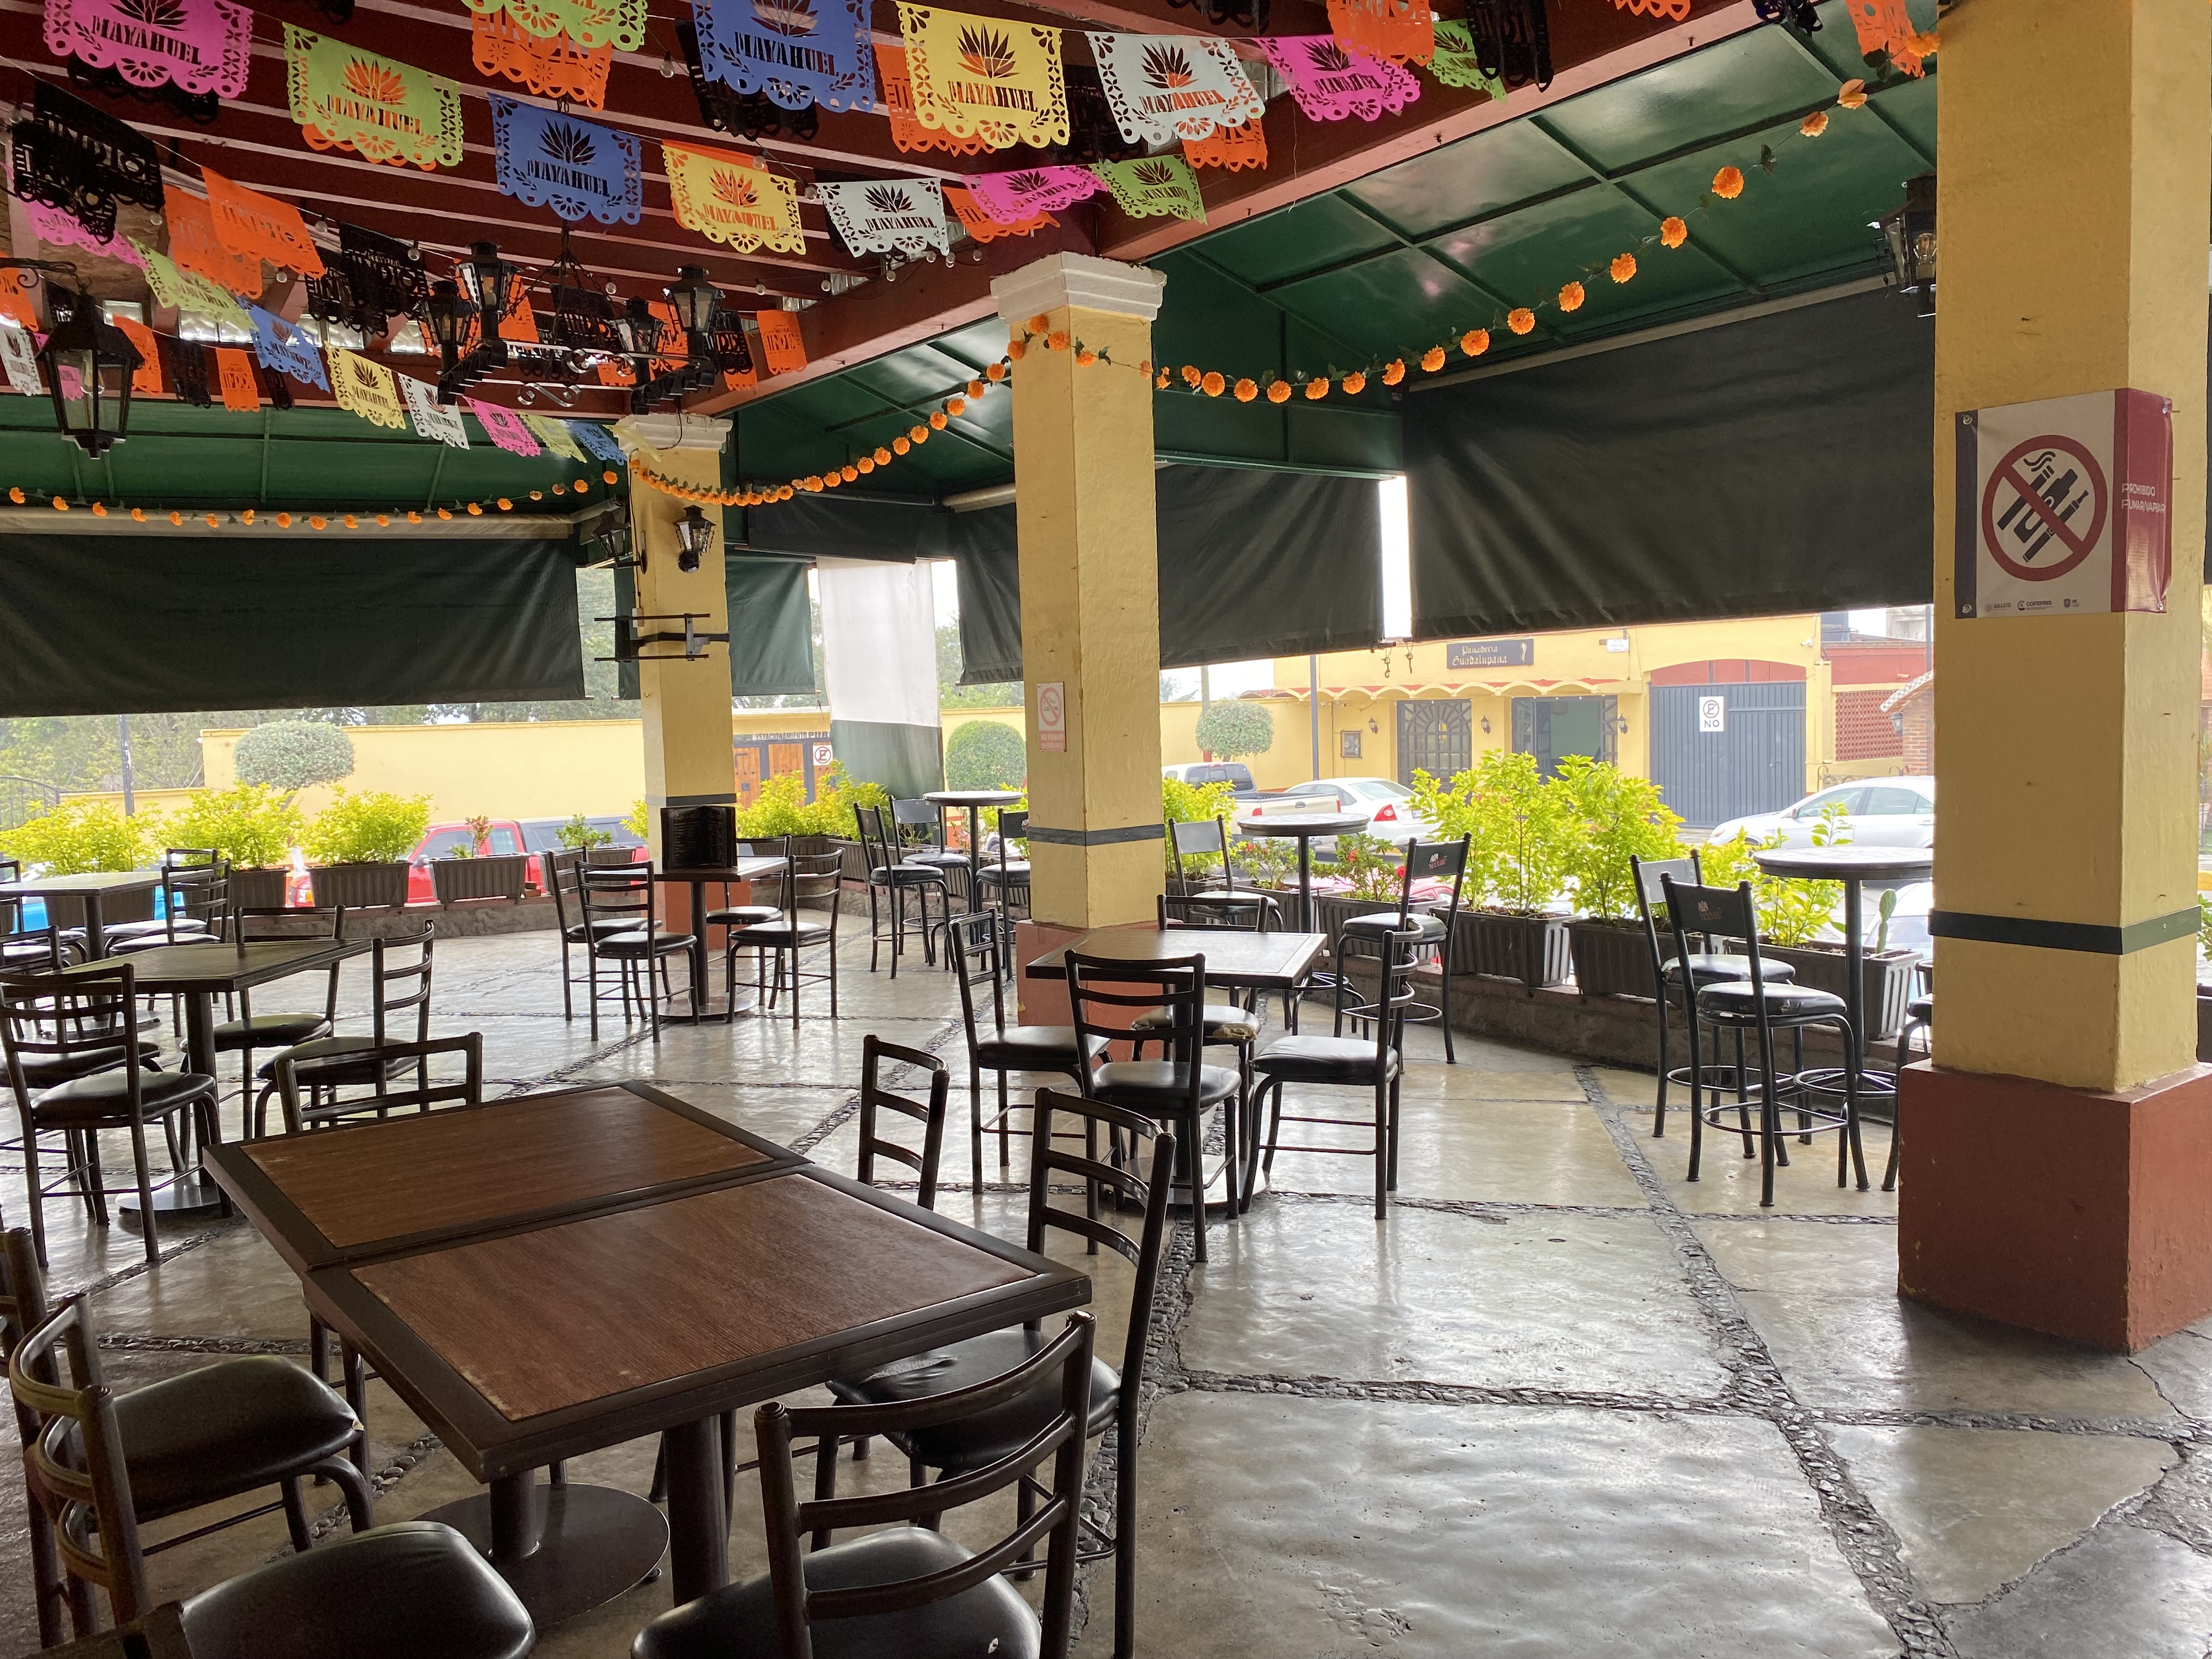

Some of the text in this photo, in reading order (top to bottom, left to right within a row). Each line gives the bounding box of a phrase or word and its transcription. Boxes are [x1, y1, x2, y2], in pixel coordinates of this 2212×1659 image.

[92, 15, 202, 65] MAYAHUEL
[734, 31, 839, 76] MAYAHUEL
[947, 81, 1038, 112] MAYAHUEL
[1138, 89, 1226, 114] MAYAHUEL
[326, 94, 424, 137] MAYAHUEL
[527, 158, 610, 197] MAYAHUEL
[702, 203, 779, 231] MAYAHUEL
[865, 217, 938, 232] MAYAHUEL
[2122, 483, 2156, 496] PROHIBIDO
[1452, 654, 1508, 666] Guadalupana
[756, 732, 808, 741] ESTACIONAMIENTO
[1704, 719, 1720, 728] NO
